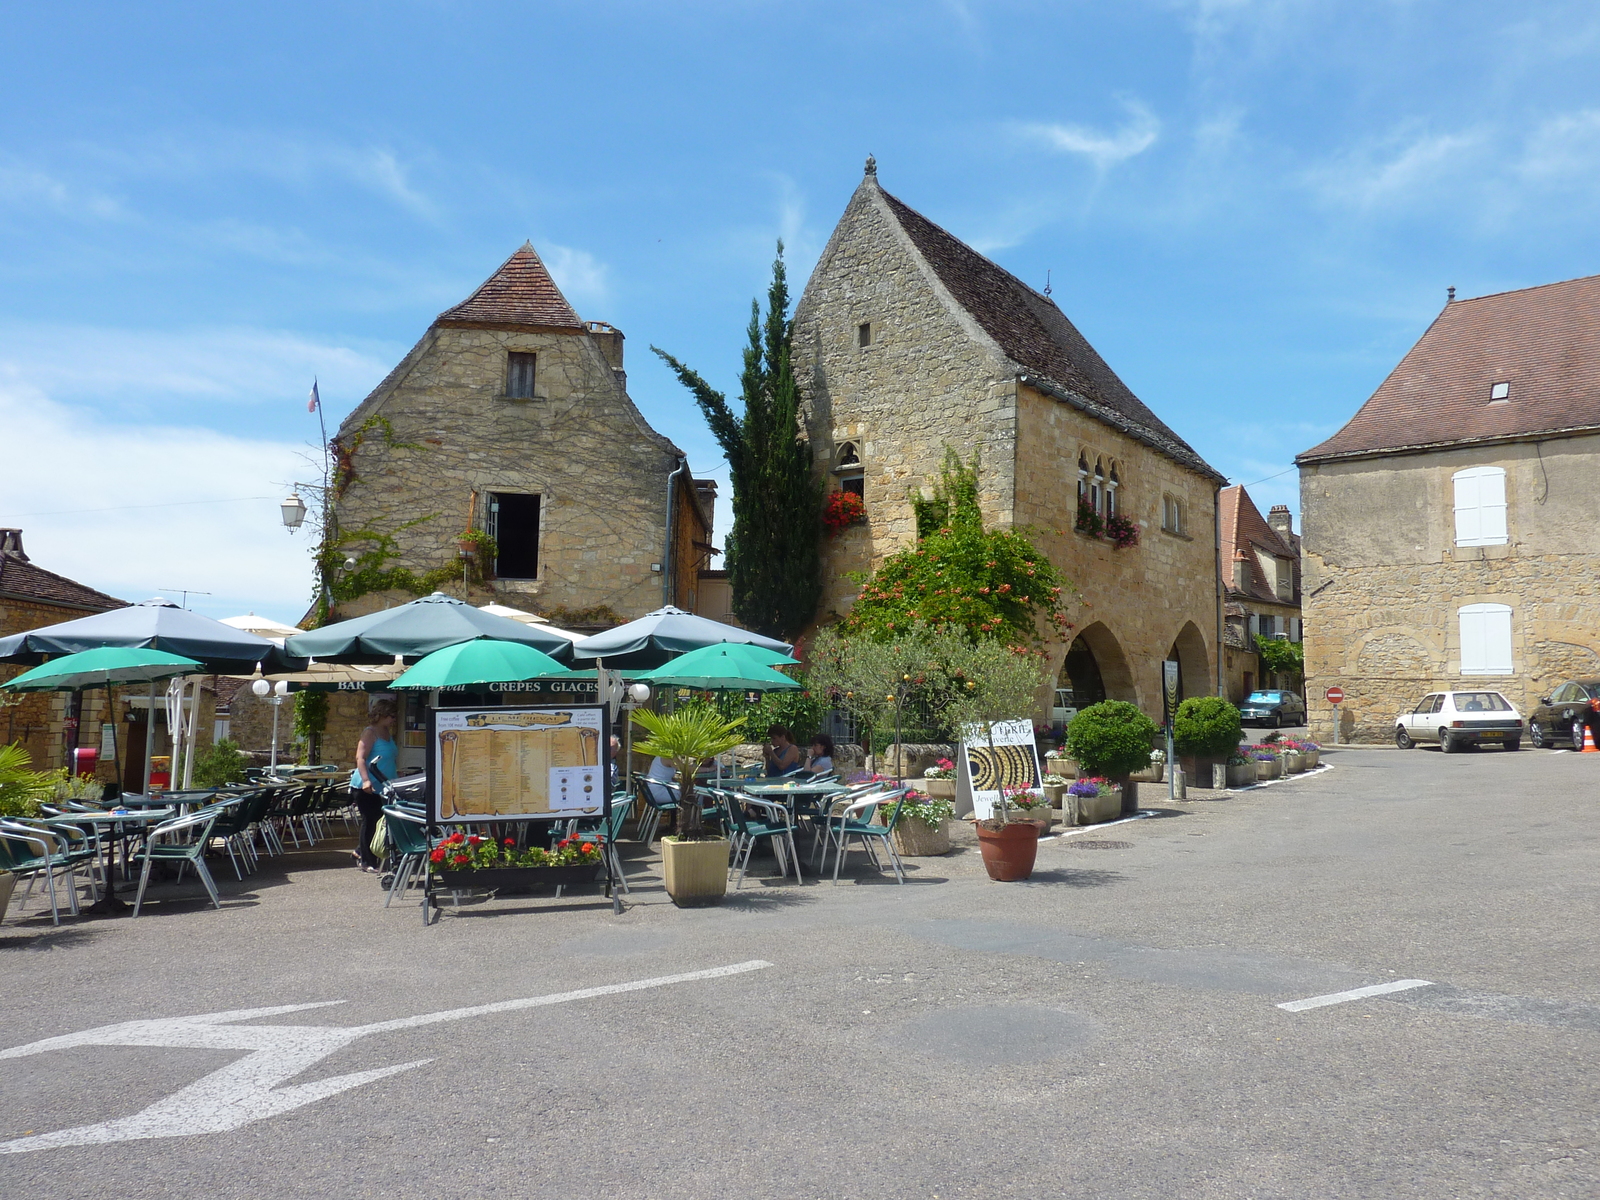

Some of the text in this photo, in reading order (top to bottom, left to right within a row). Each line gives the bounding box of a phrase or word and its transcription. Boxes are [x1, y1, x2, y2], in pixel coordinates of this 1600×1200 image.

[337, 681, 366, 690] BAR
[489, 682, 600, 693] CREPES GLACES
